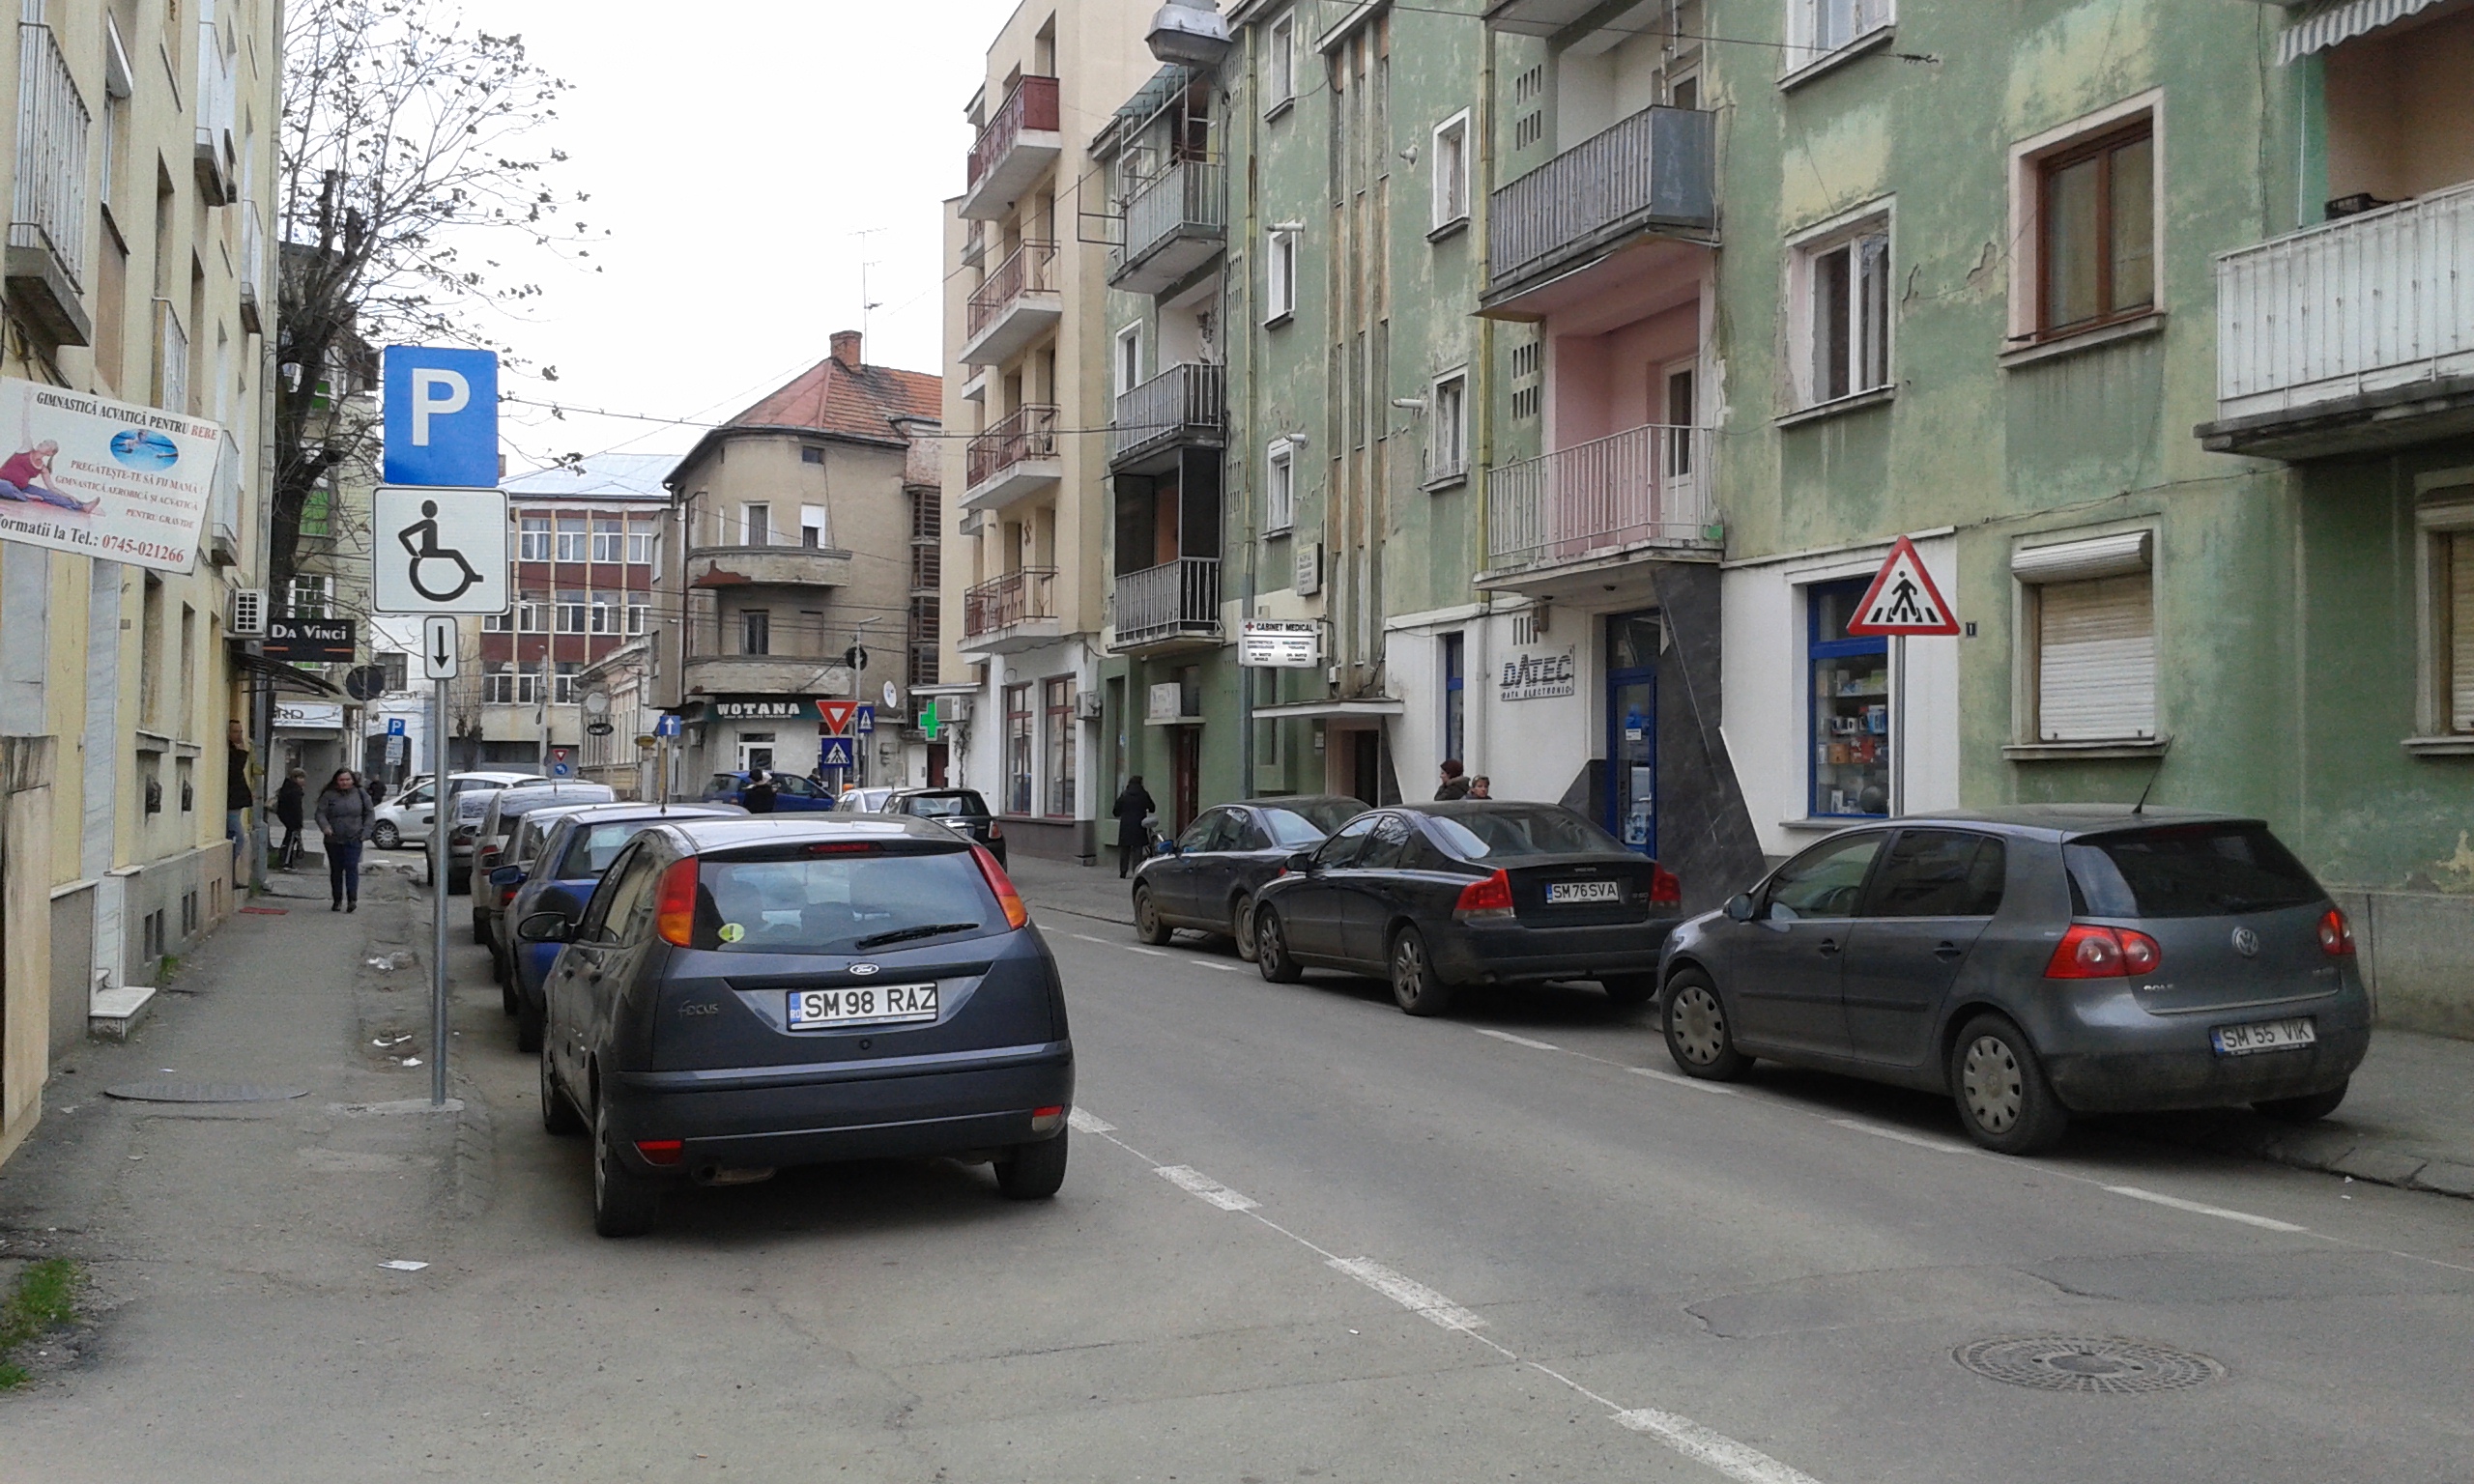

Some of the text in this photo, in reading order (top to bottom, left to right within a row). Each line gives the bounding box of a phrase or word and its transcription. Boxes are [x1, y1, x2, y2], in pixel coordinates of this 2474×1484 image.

[412, 367, 471, 446] P
[149, 416, 189, 434] PENTRU
[191, 425, 217, 440] BEBE
[53, 525, 65, 540] la
[101, 534, 185, 562] 0745-021266
[1256, 622, 1313, 632] CABINET MEDICAL
[1502, 654, 1571, 689] DATEC
[717, 702, 800, 715] WOTANA
[391, 720, 402, 733] P
[805, 992, 840, 1017] SM
[846, 990, 875, 1015] 98
[887, 986, 935, 1013] RAZ
[2224, 1026, 2251, 1048] SM
[2255, 1027, 2275, 1043] 55
